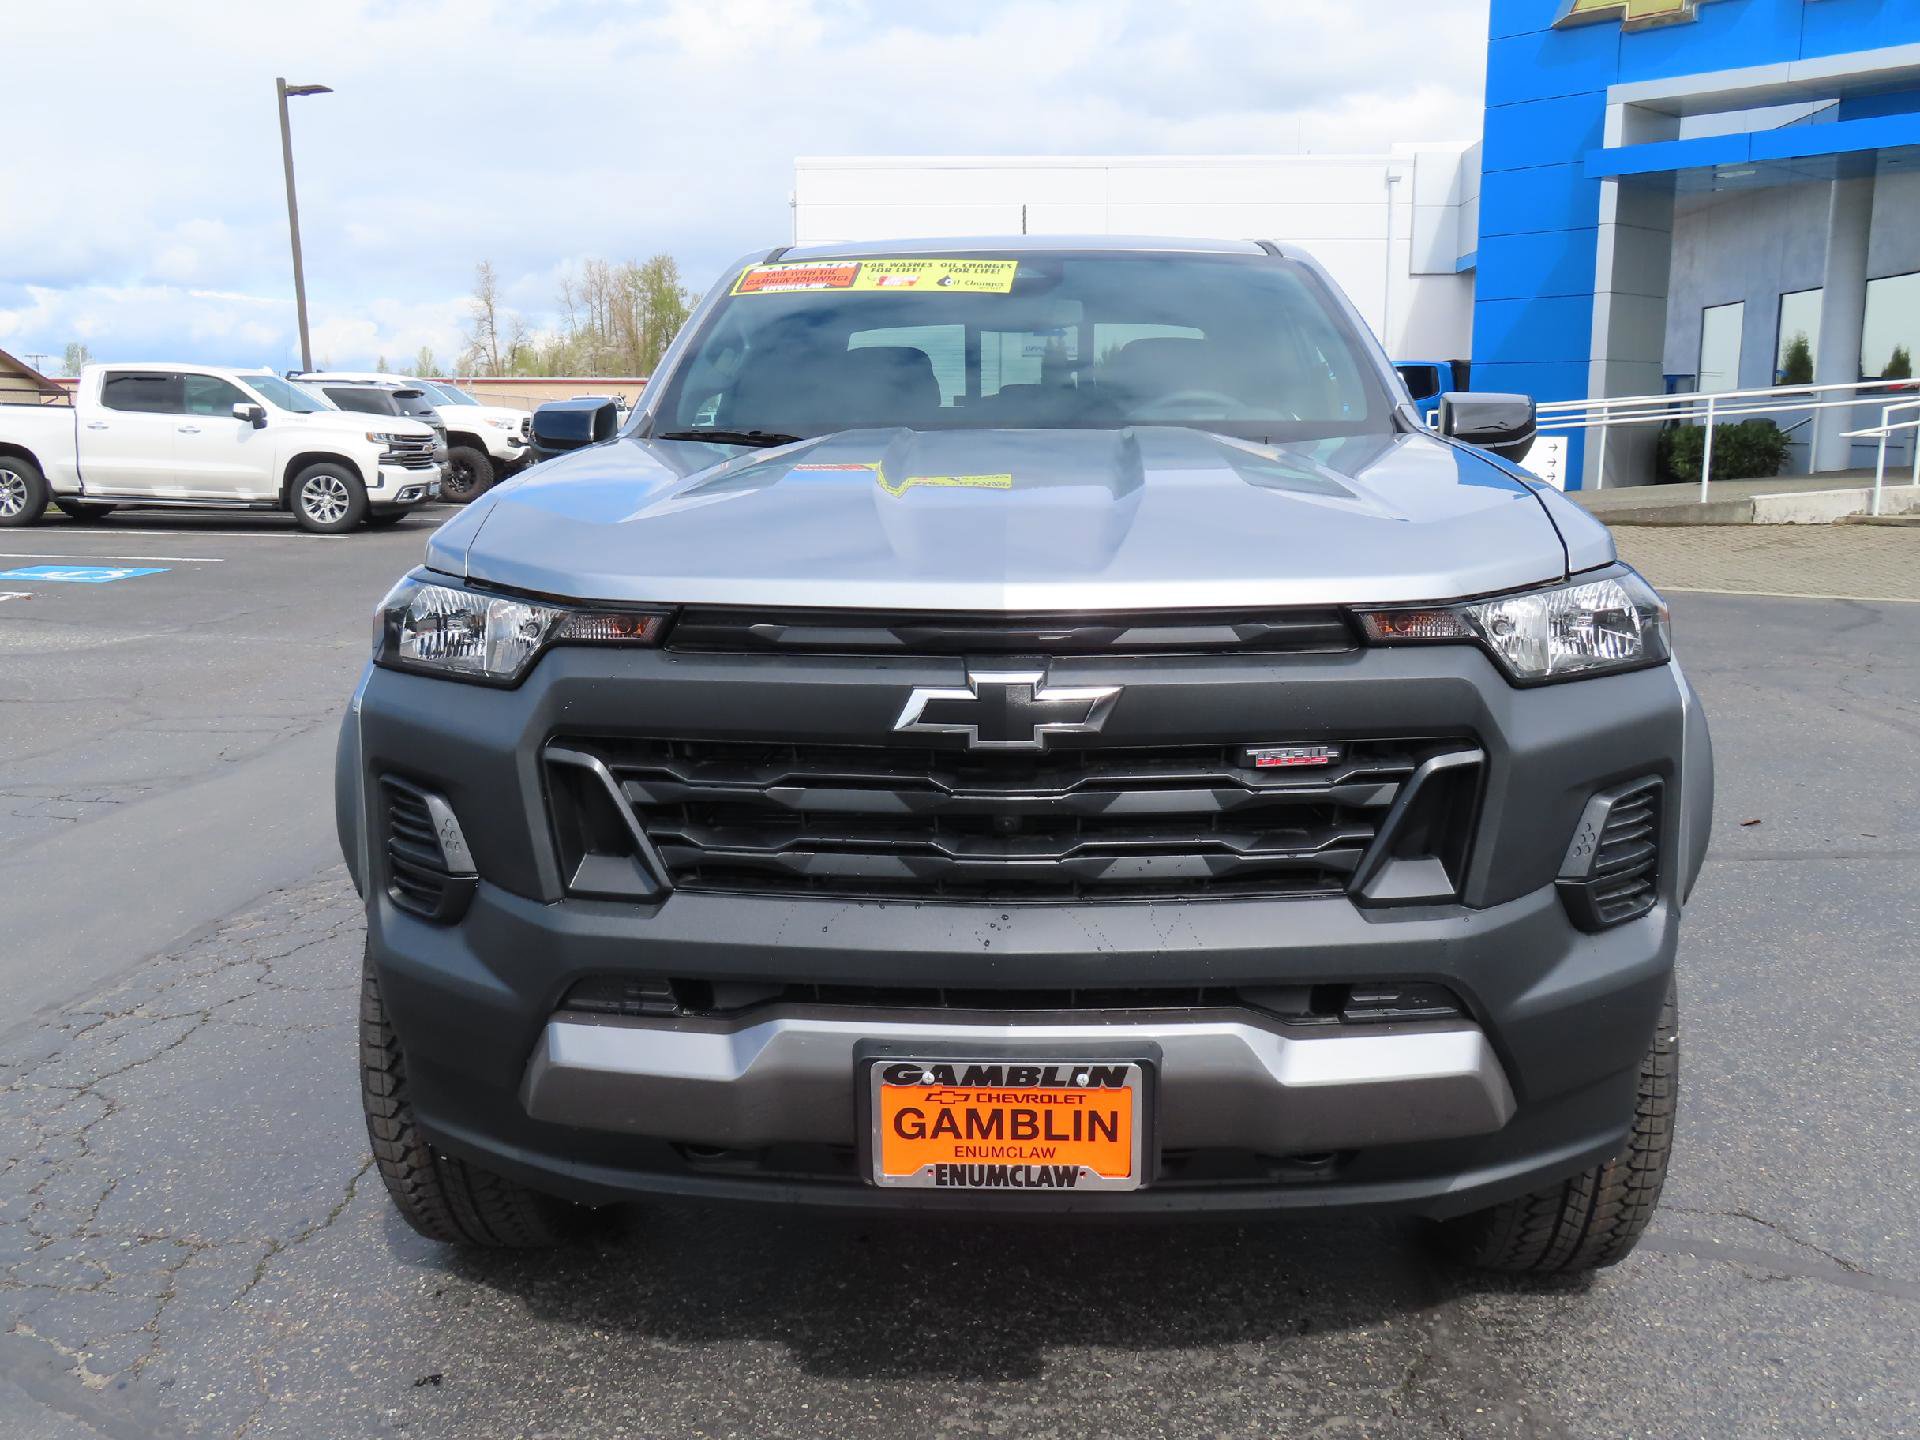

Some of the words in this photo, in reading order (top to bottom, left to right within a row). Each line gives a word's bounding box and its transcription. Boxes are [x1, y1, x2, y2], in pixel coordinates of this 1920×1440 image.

[792, 275, 850, 283] ADVANTAGE
[882, 1063, 1129, 1087] GAMBLIN
[976, 1092, 1087, 1105] CHEVROLET
[893, 1107, 1119, 1142] GAMBLIN
[954, 1145, 1057, 1159] ENUMCLAW
[935, 1163, 1081, 1188] ENUMCLAW
